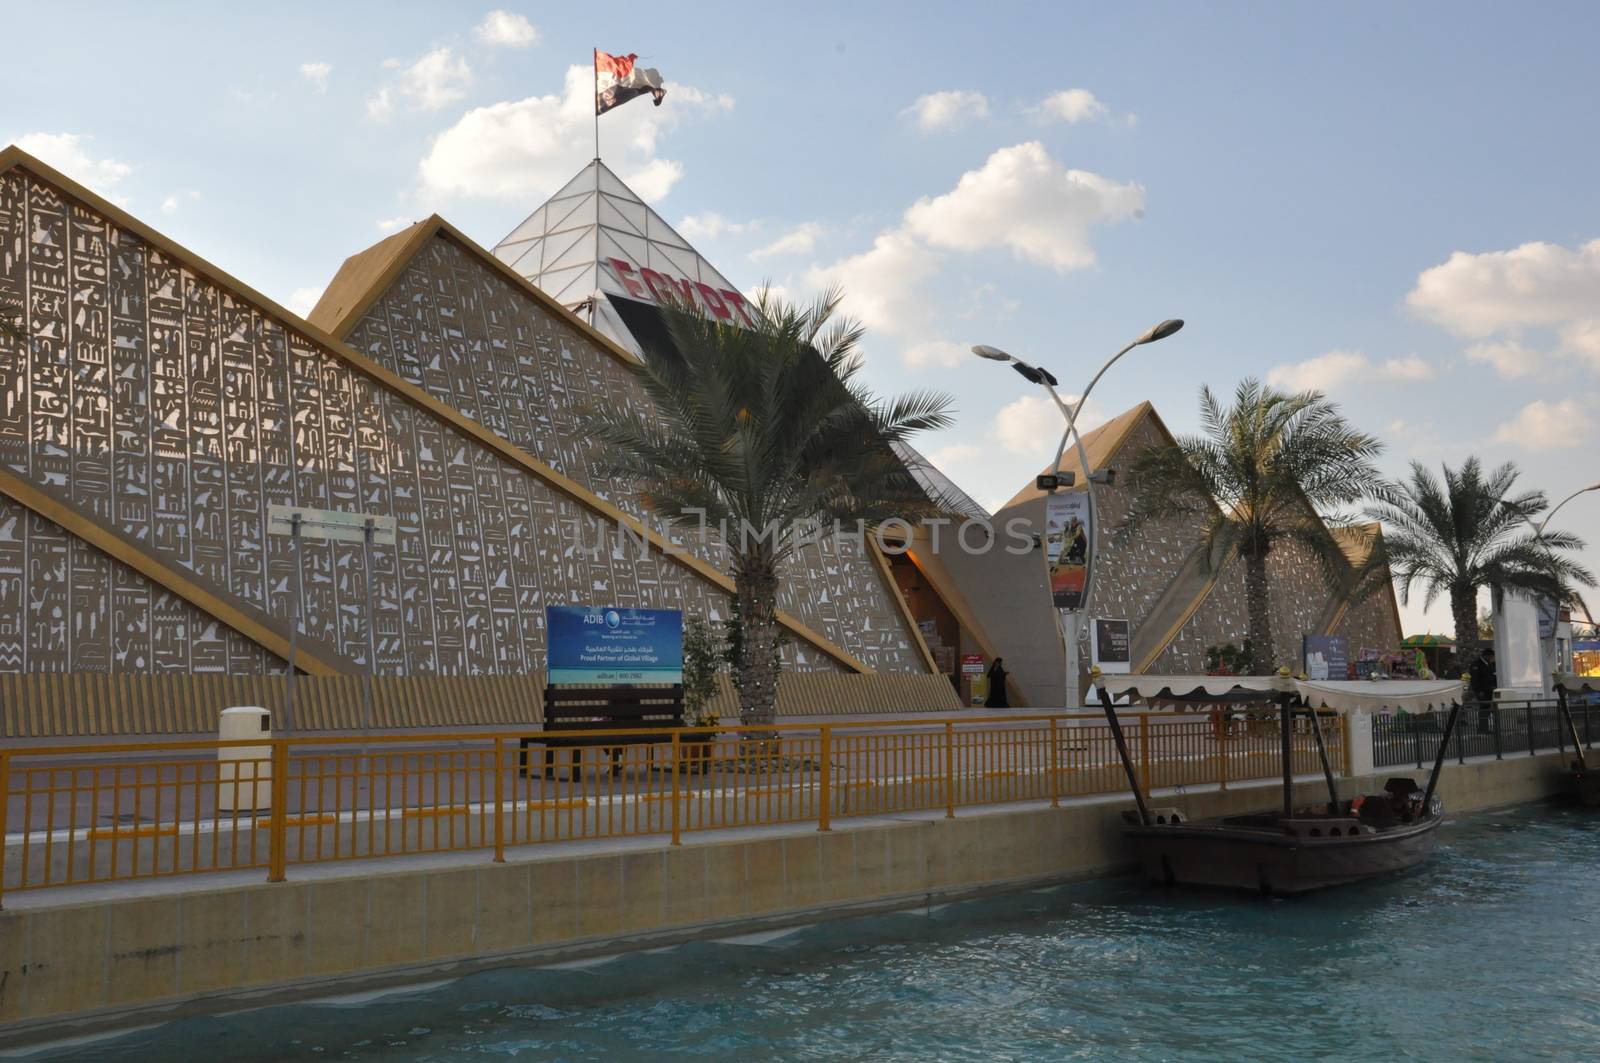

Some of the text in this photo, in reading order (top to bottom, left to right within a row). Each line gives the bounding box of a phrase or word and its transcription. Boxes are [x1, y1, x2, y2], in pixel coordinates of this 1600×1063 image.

[607, 256, 754, 329] EGYPT
[583, 615, 604, 624] ADIB
[641, 655, 658, 663] Village
